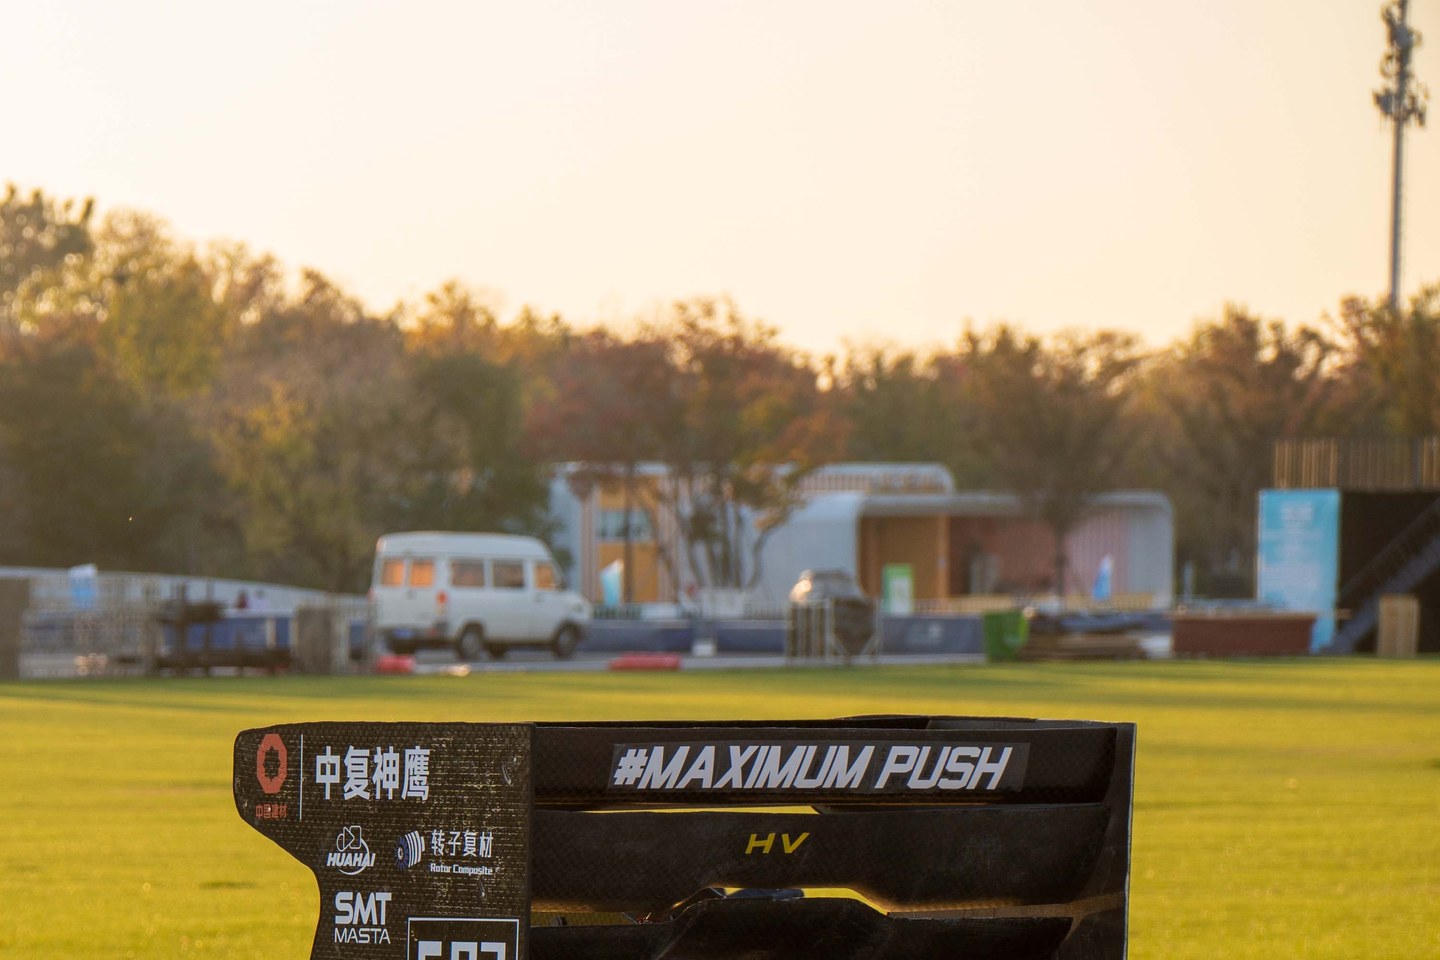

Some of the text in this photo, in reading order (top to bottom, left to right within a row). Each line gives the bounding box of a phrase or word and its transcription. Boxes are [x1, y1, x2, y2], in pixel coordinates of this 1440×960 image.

[315, 745, 430, 800] 中复神鹰
[613, 744, 1013, 790] #MAXIMUM PUSH
[431, 829, 494, 858] 转子复材
[327, 852, 375, 868] HUAHAI
[430, 863, 493, 876] Rotor Composite
[334, 891, 392, 925] SMT
[334, 927, 391, 944] MASTA
